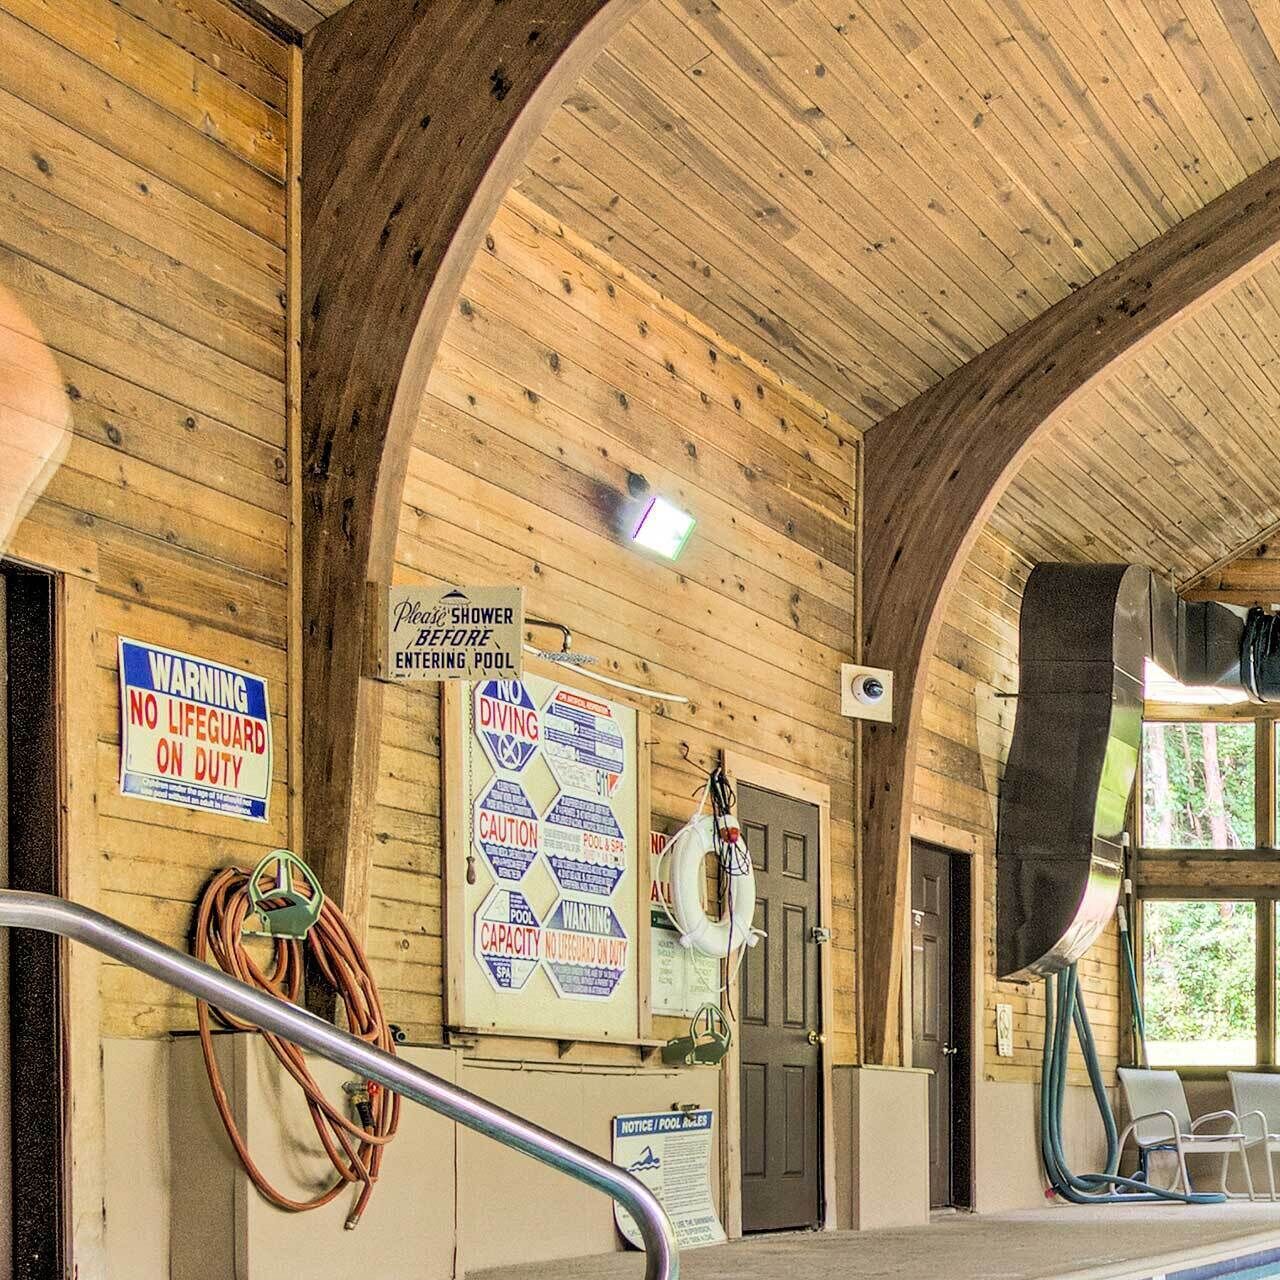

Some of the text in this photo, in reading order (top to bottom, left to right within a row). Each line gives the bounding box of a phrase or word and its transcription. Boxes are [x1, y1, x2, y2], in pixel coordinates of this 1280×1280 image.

[393, 597, 513, 632] Please SHOWER
[415, 629, 494, 646] BEFORE
[396, 652, 514, 669] ENTERING POOL
[148, 651, 249, 713] WARNING
[497, 680, 522, 705] NO
[130, 690, 265, 755] NO LIFEGUARD
[480, 698, 538, 740] DIVING
[157, 738, 243, 787] ON DUTY
[480, 812, 537, 848] CAUTION
[583, 833, 603, 850] POOL
[511, 909, 534, 925] POOL
[562, 901, 612, 935] WARNING
[481, 922, 540, 957] CAPACITY
[546, 931, 556, 960] NO
[559, 933, 595, 963] LIFEGUARD
[599, 938, 608, 964] ON
[610, 940, 627, 967] DUTY
[496, 966, 511, 978] SPA
[622, 1120, 653, 1134] NOTICE
[659, 1117, 681, 1129] POOL
